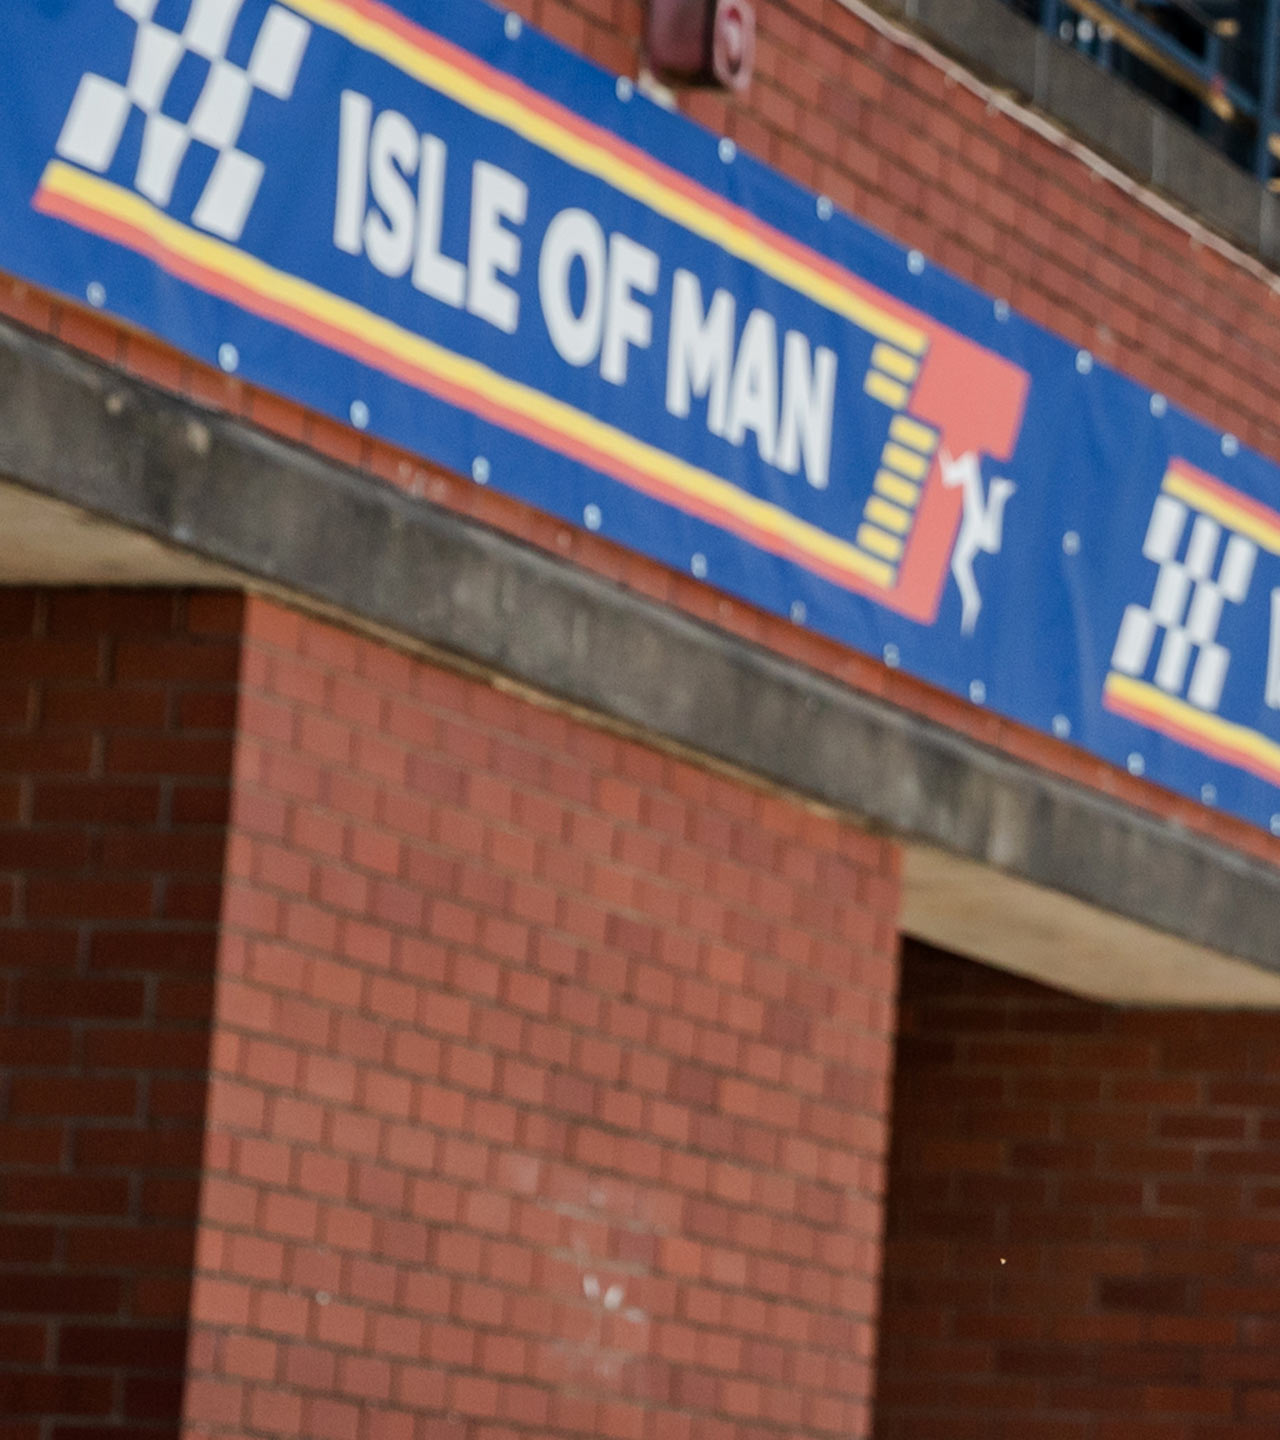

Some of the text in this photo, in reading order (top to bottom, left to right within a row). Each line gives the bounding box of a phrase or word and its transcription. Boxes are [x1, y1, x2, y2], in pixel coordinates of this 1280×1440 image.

[333, 89, 837, 490] ISLE OF MAN
